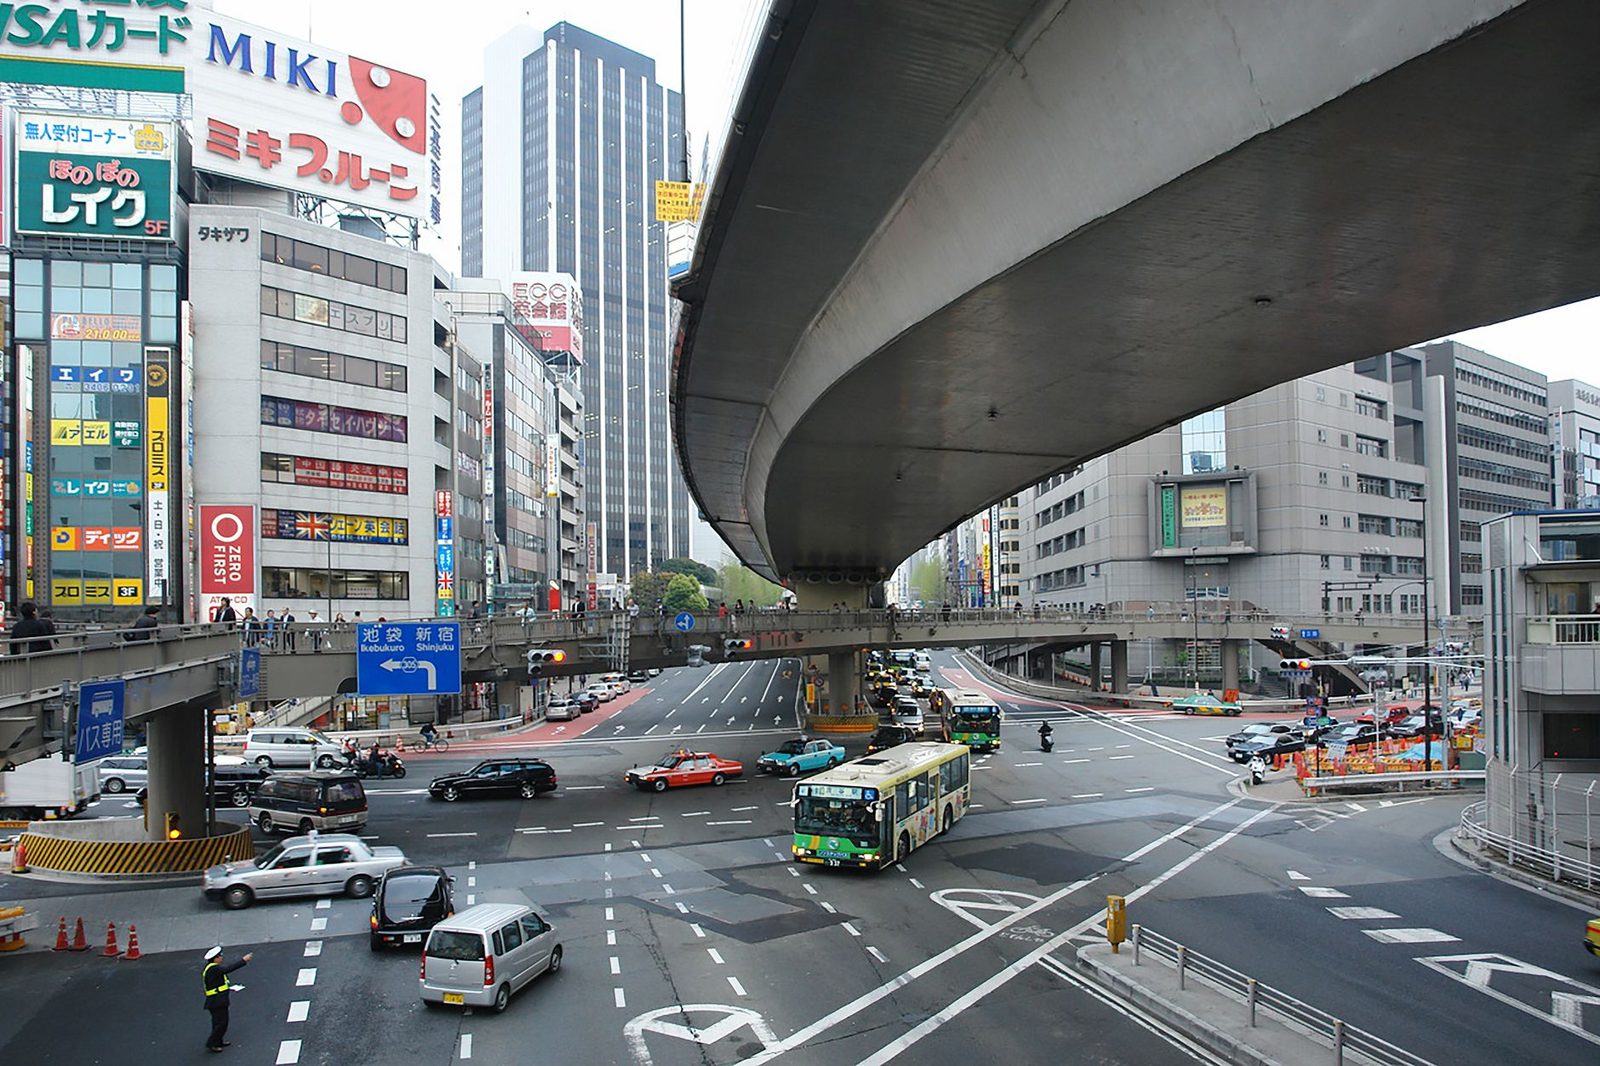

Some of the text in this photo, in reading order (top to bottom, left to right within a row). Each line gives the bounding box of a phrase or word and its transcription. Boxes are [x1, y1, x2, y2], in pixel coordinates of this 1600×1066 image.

[207, 23, 337, 98] MIKI
[24, 122, 127, 144] 無人受付コーナー
[206, 118, 418, 200] ミキプルーン
[49, 159, 140, 187] ほのぼの
[42, 184, 146, 227] レイク
[144, 220, 169, 235] 5F
[198, 226, 250, 242] タキザワ
[513, 282, 567, 301] ECC
[58, 367, 134, 382] エイワ
[69, 428, 108, 440] アエル
[151, 430, 165, 476] プロミス
[67, 481, 109, 493] レイク
[85, 530, 140, 545] ディック
[213, 545, 226, 584] FIRST
[228, 545, 242, 582] ZERO
[55, 586, 111, 598] プロミス
[119, 587, 136, 597] 3F
[362, 627, 454, 643] 池袋 新宿
[360, 643, 455, 653] Ikebukuro Shinjuku
[78, 719, 123, 754] バス専用
